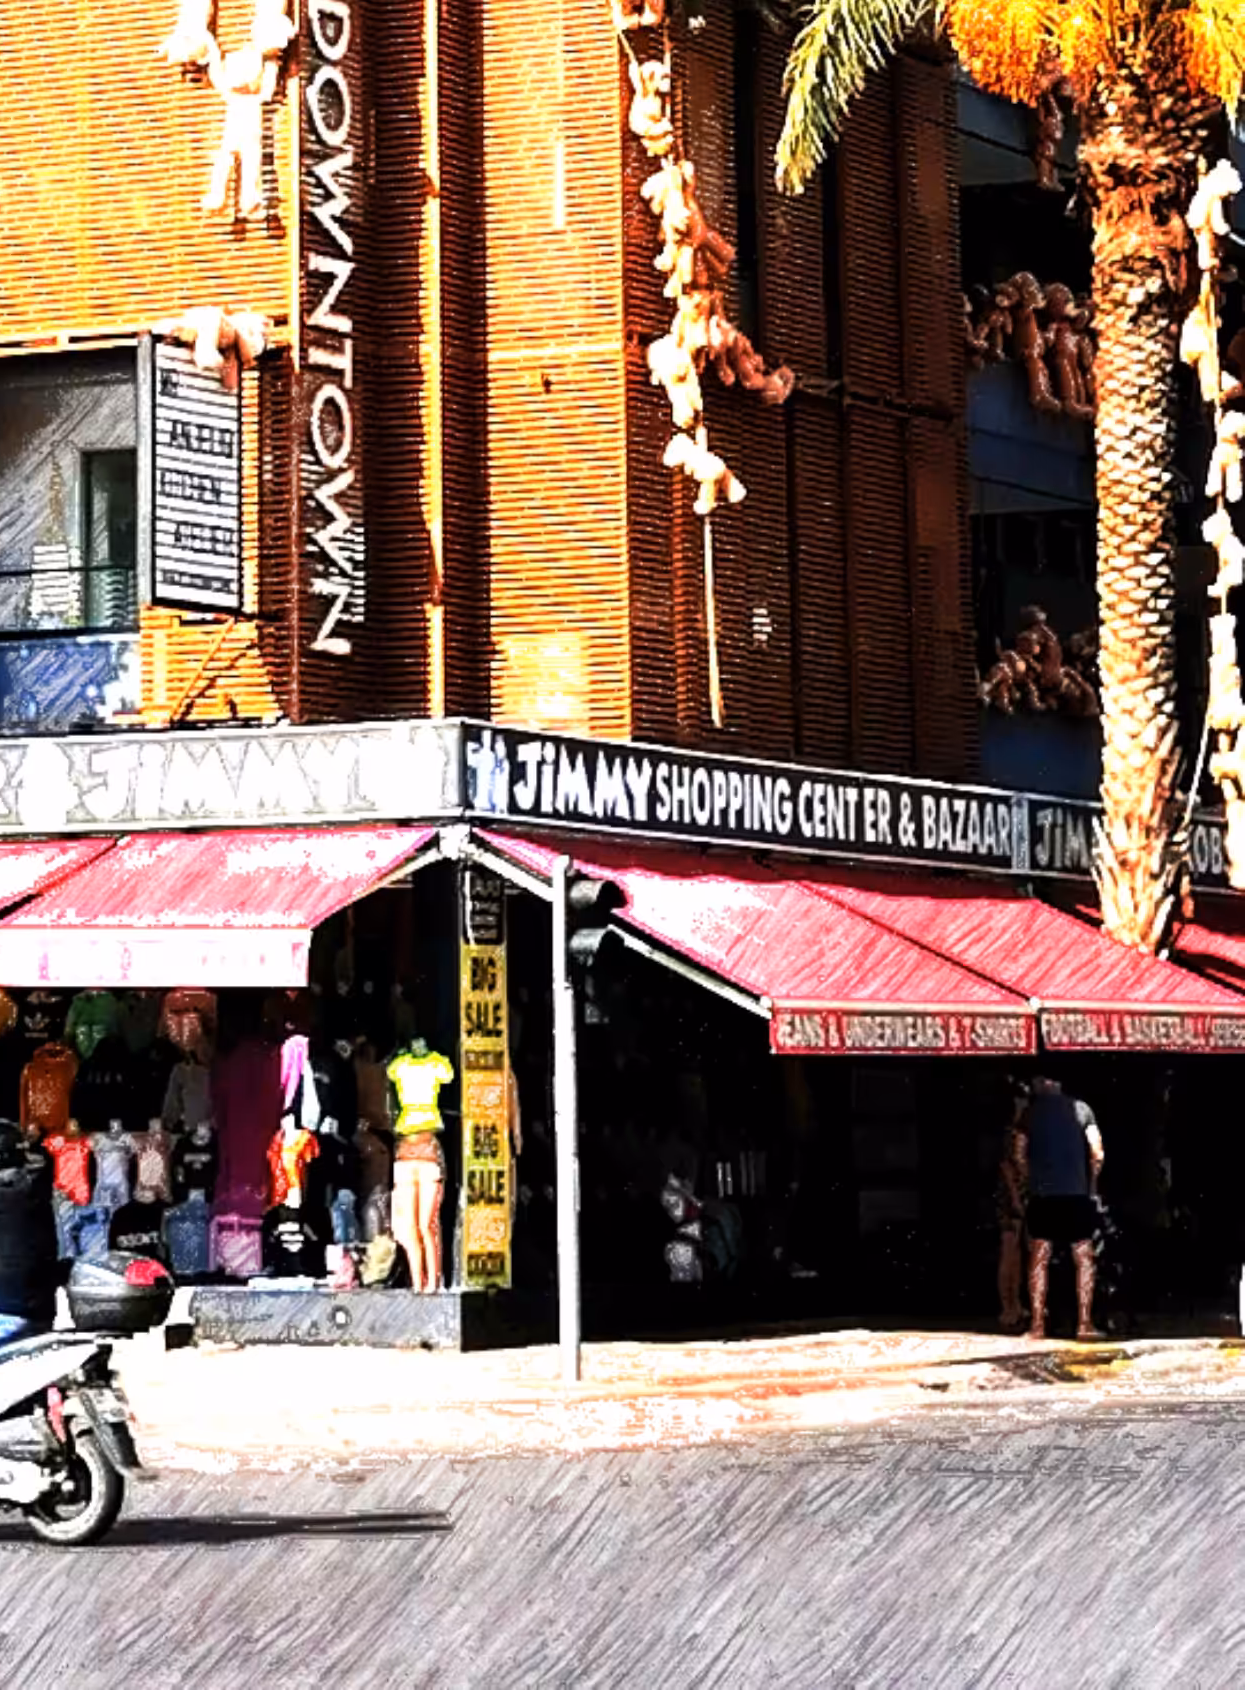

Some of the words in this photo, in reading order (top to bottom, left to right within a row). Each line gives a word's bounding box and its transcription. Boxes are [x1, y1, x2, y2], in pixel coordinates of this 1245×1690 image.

[656, 763, 792, 836] SHOPPING
[899, 791, 917, 848] &
[922, 794, 1011, 856] BAZAAR
[465, 1001, 503, 1038] SALE
[467, 1168, 505, 1206] SALE
